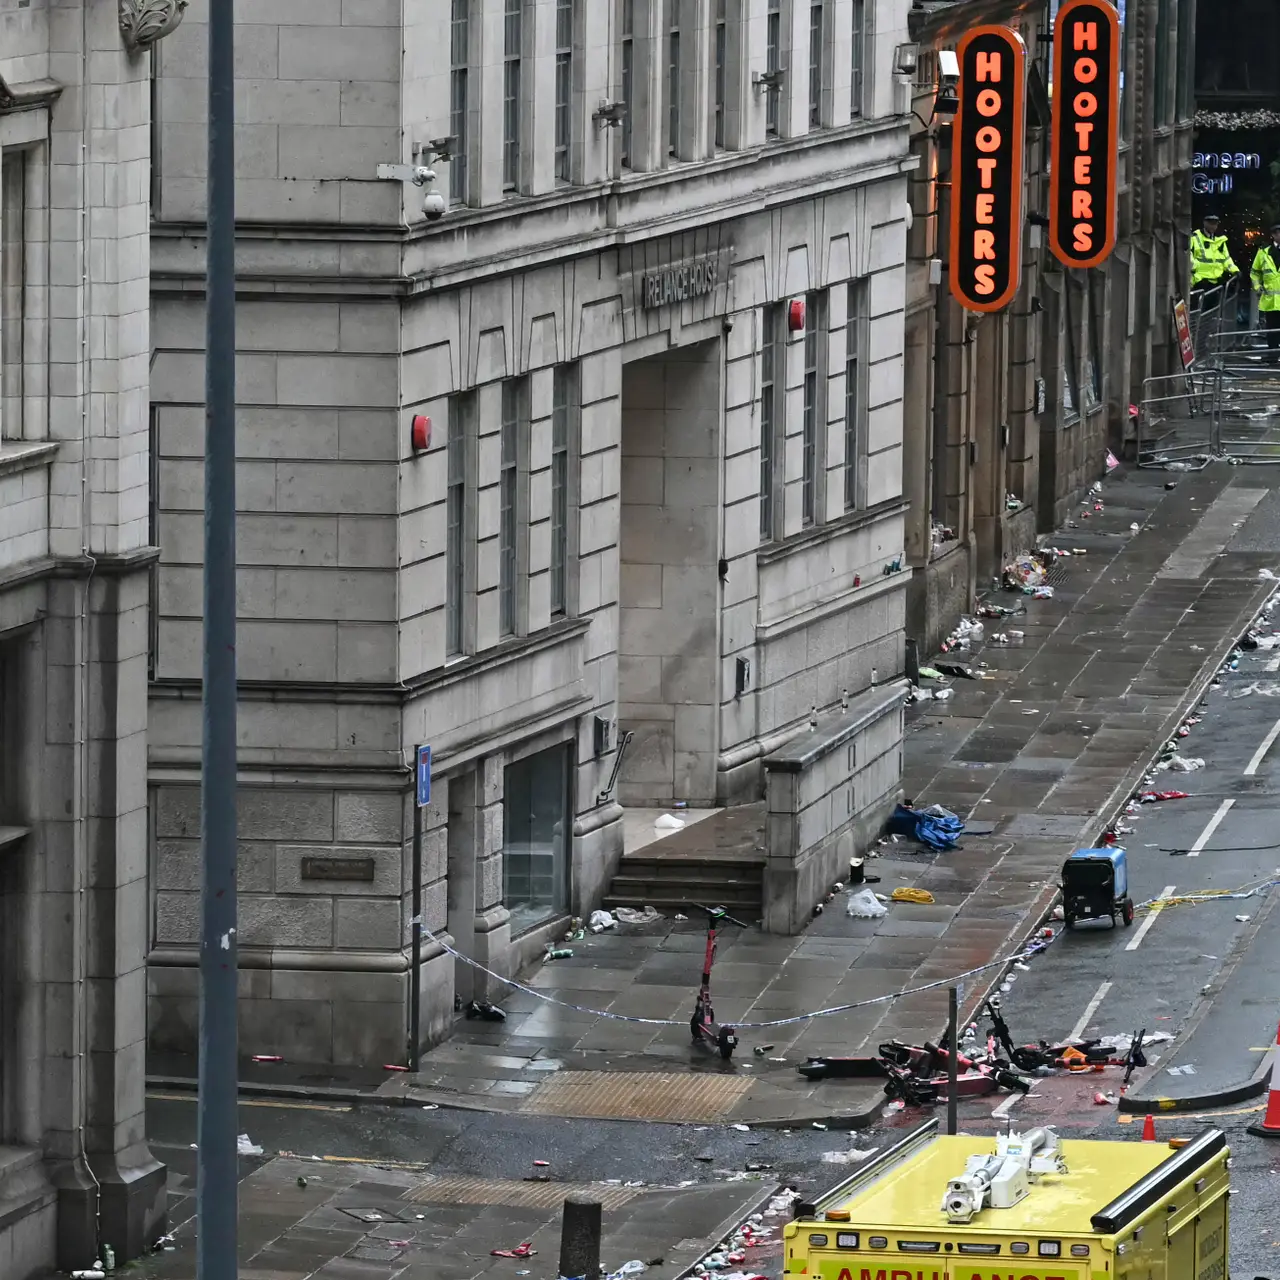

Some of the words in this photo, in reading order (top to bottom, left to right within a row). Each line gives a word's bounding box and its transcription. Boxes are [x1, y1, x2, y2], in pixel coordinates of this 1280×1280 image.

[973, 52, 1002, 295] HOOTERS
[1072, 22, 1098, 252] HOOTERS
[647, 266, 688, 308] RELIANCE
